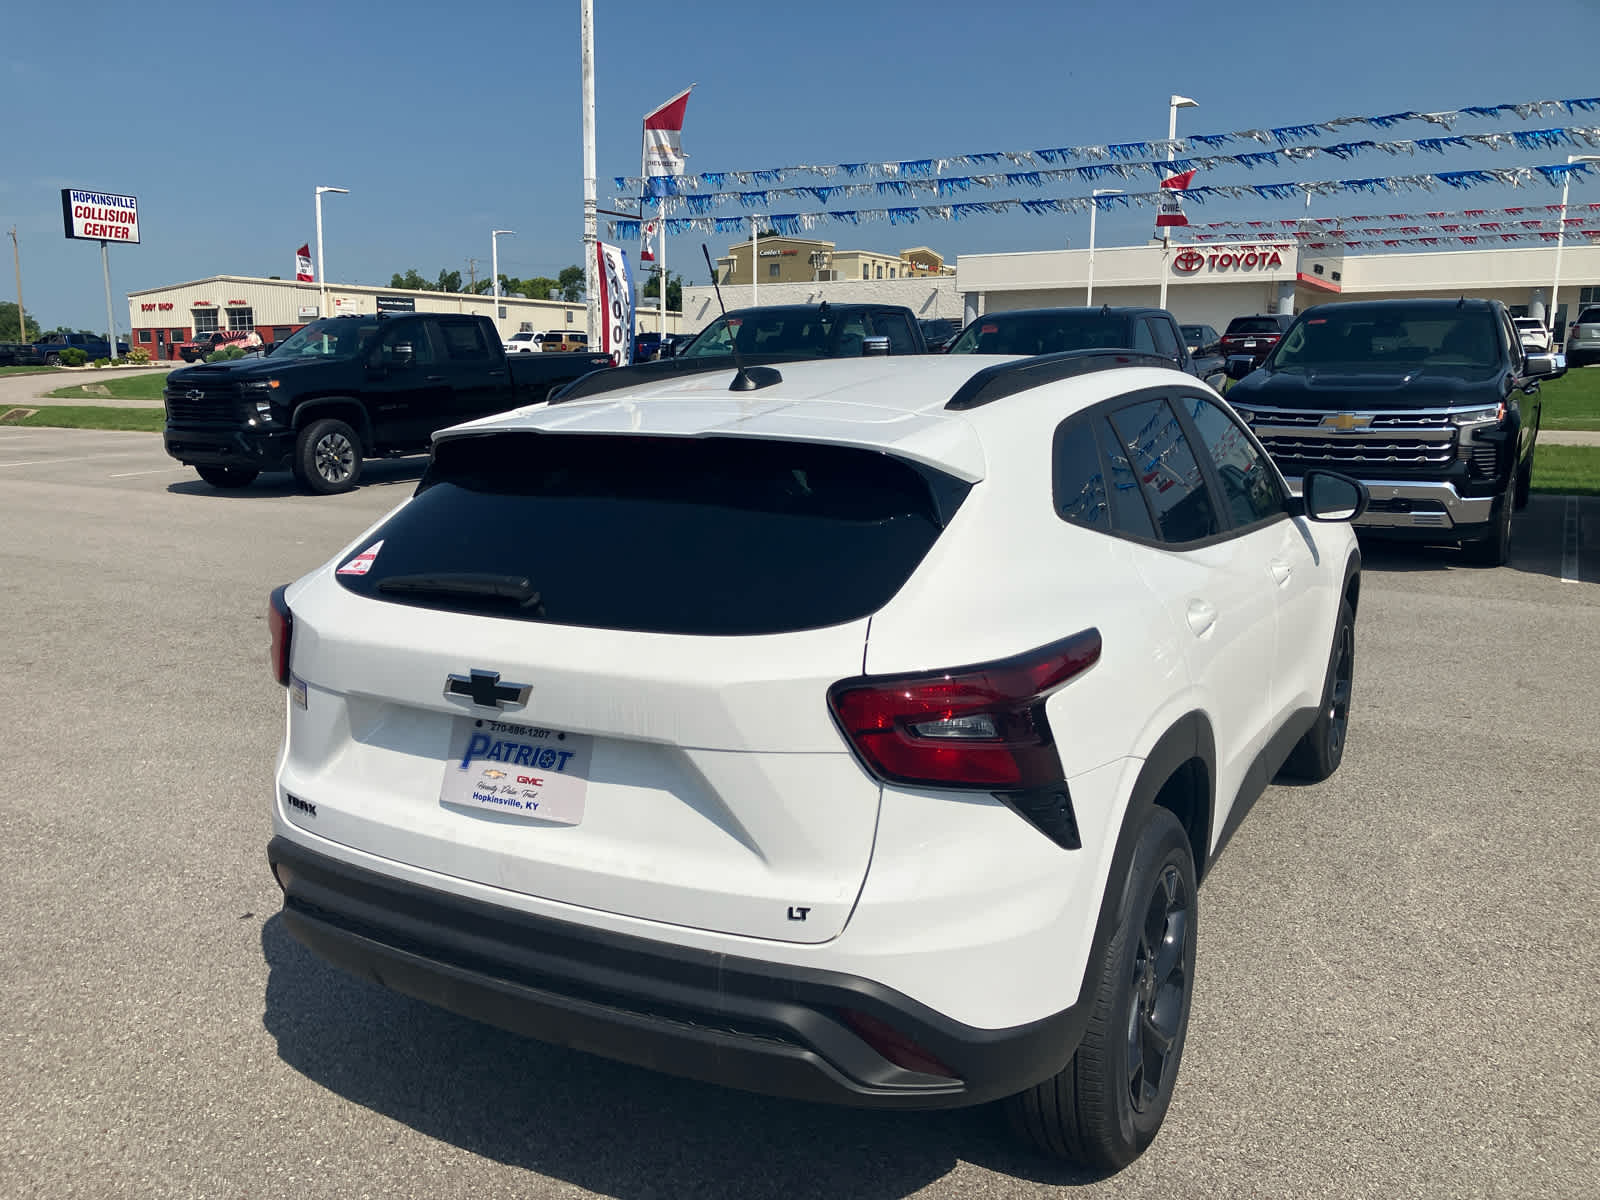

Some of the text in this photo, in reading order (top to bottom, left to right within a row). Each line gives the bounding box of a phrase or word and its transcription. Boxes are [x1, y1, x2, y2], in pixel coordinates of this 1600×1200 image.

[72, 191, 135, 209] HOPKINSVILLE
[74, 205, 136, 224] COLLISION
[84, 222, 129, 239] CENTER
[1209, 252, 1282, 268] TOYOTA
[141, 303, 173, 312] BODY SHOP
[459, 732, 575, 771] PATRIOT
[516, 775, 544, 787] GMC
[286, 793, 317, 817] TRAX
[472, 791, 539, 811] Hopkinsville, KY
[787, 906, 811, 921] LT
